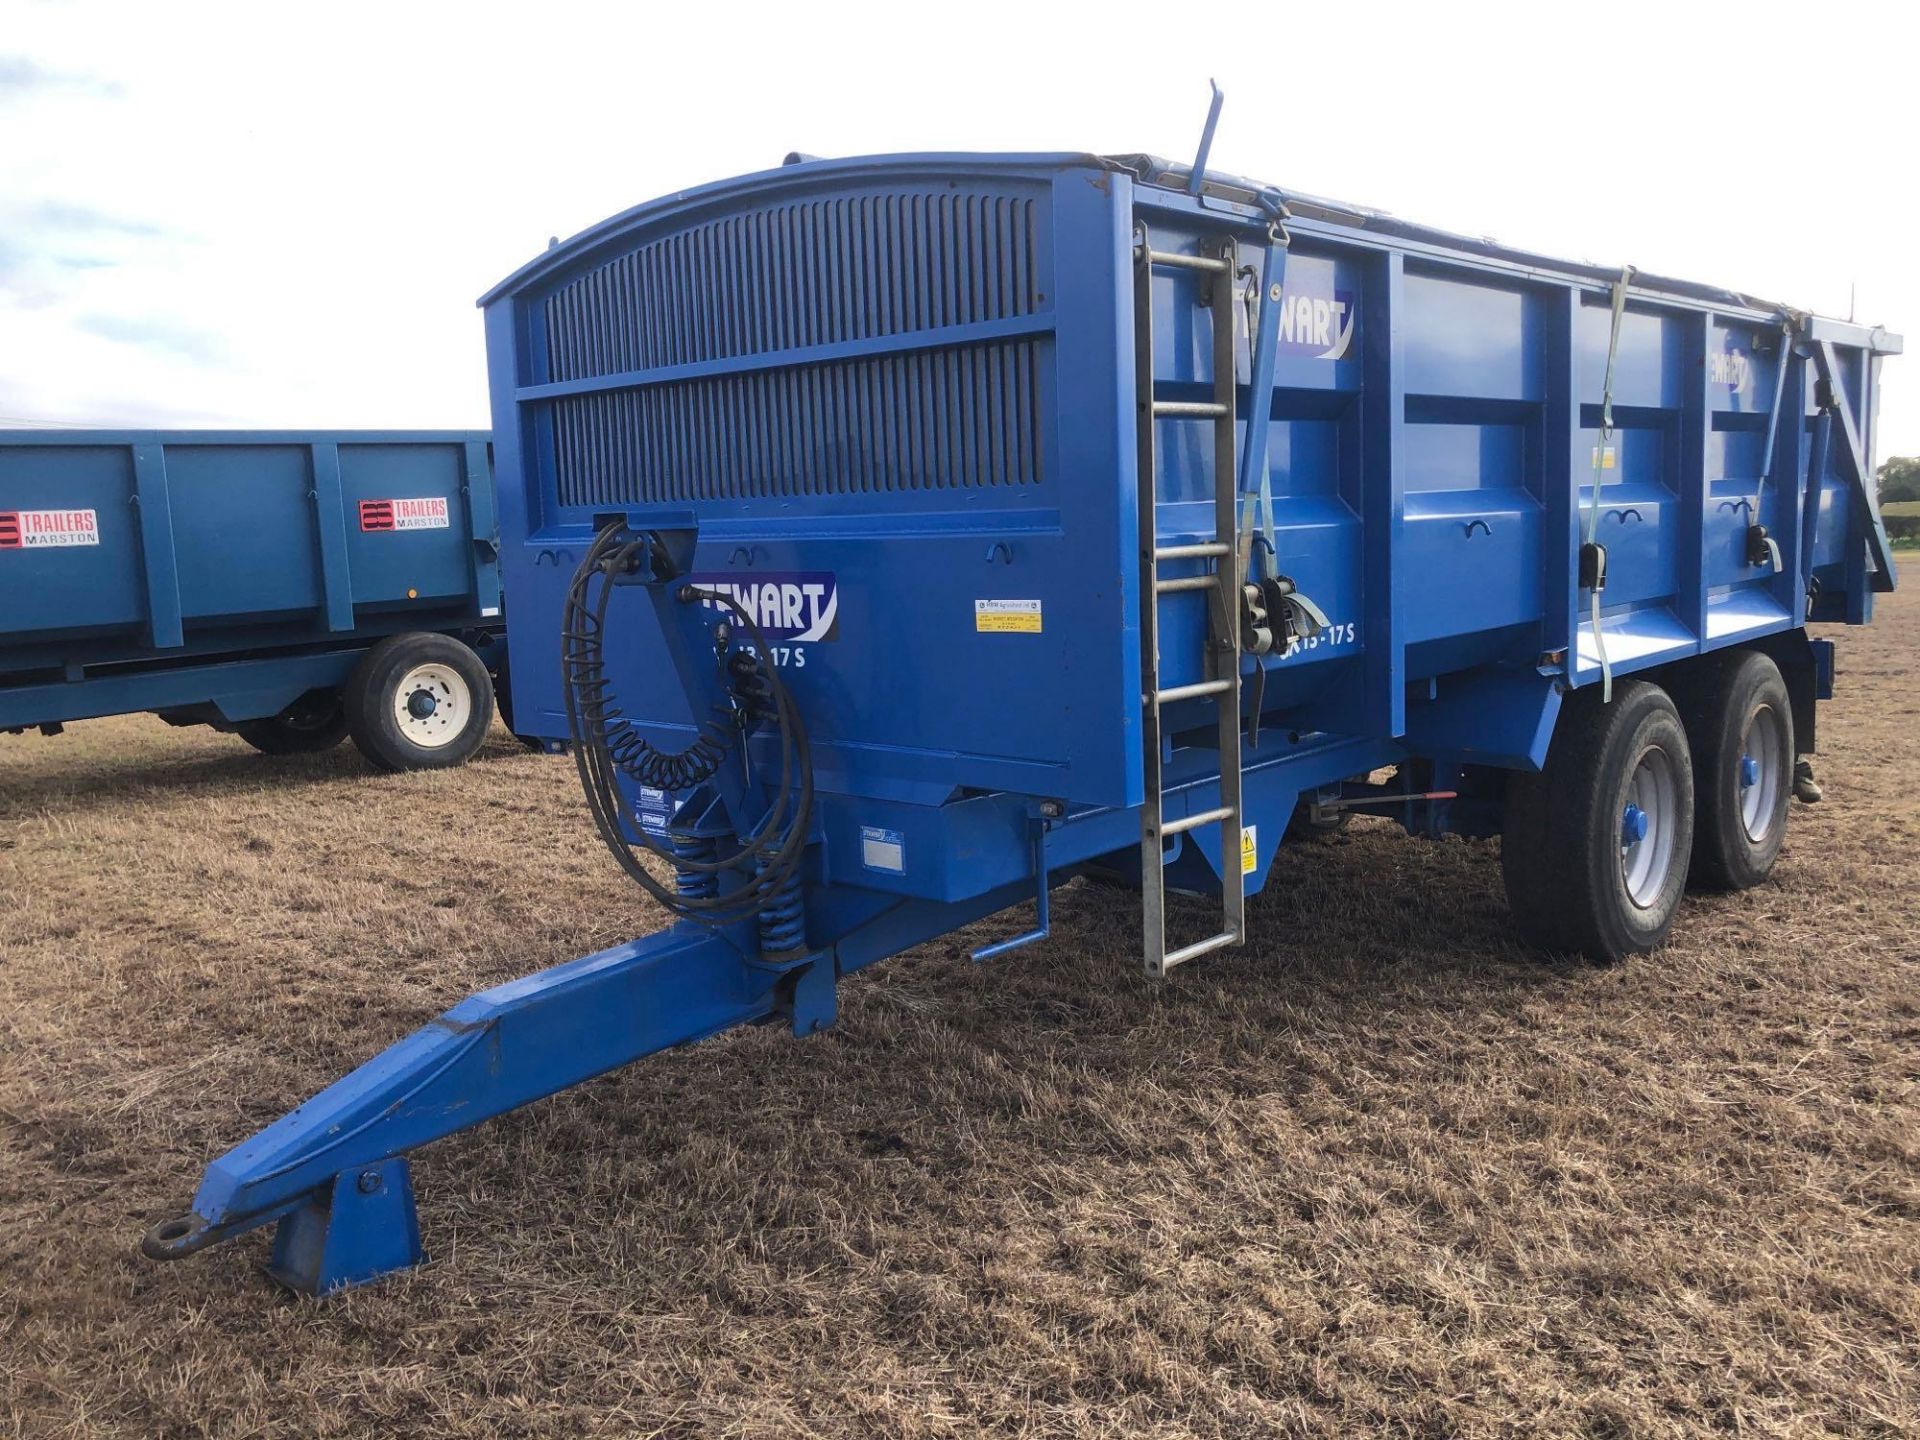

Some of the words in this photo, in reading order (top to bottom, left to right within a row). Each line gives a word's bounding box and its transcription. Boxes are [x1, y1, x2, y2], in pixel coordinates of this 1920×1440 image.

[395, 500, 446, 518] TRAILERS
[23, 512, 94, 533] TRAILERS
[397, 518, 447, 528] MARSTON
[25, 533, 95, 545] MARSTON
